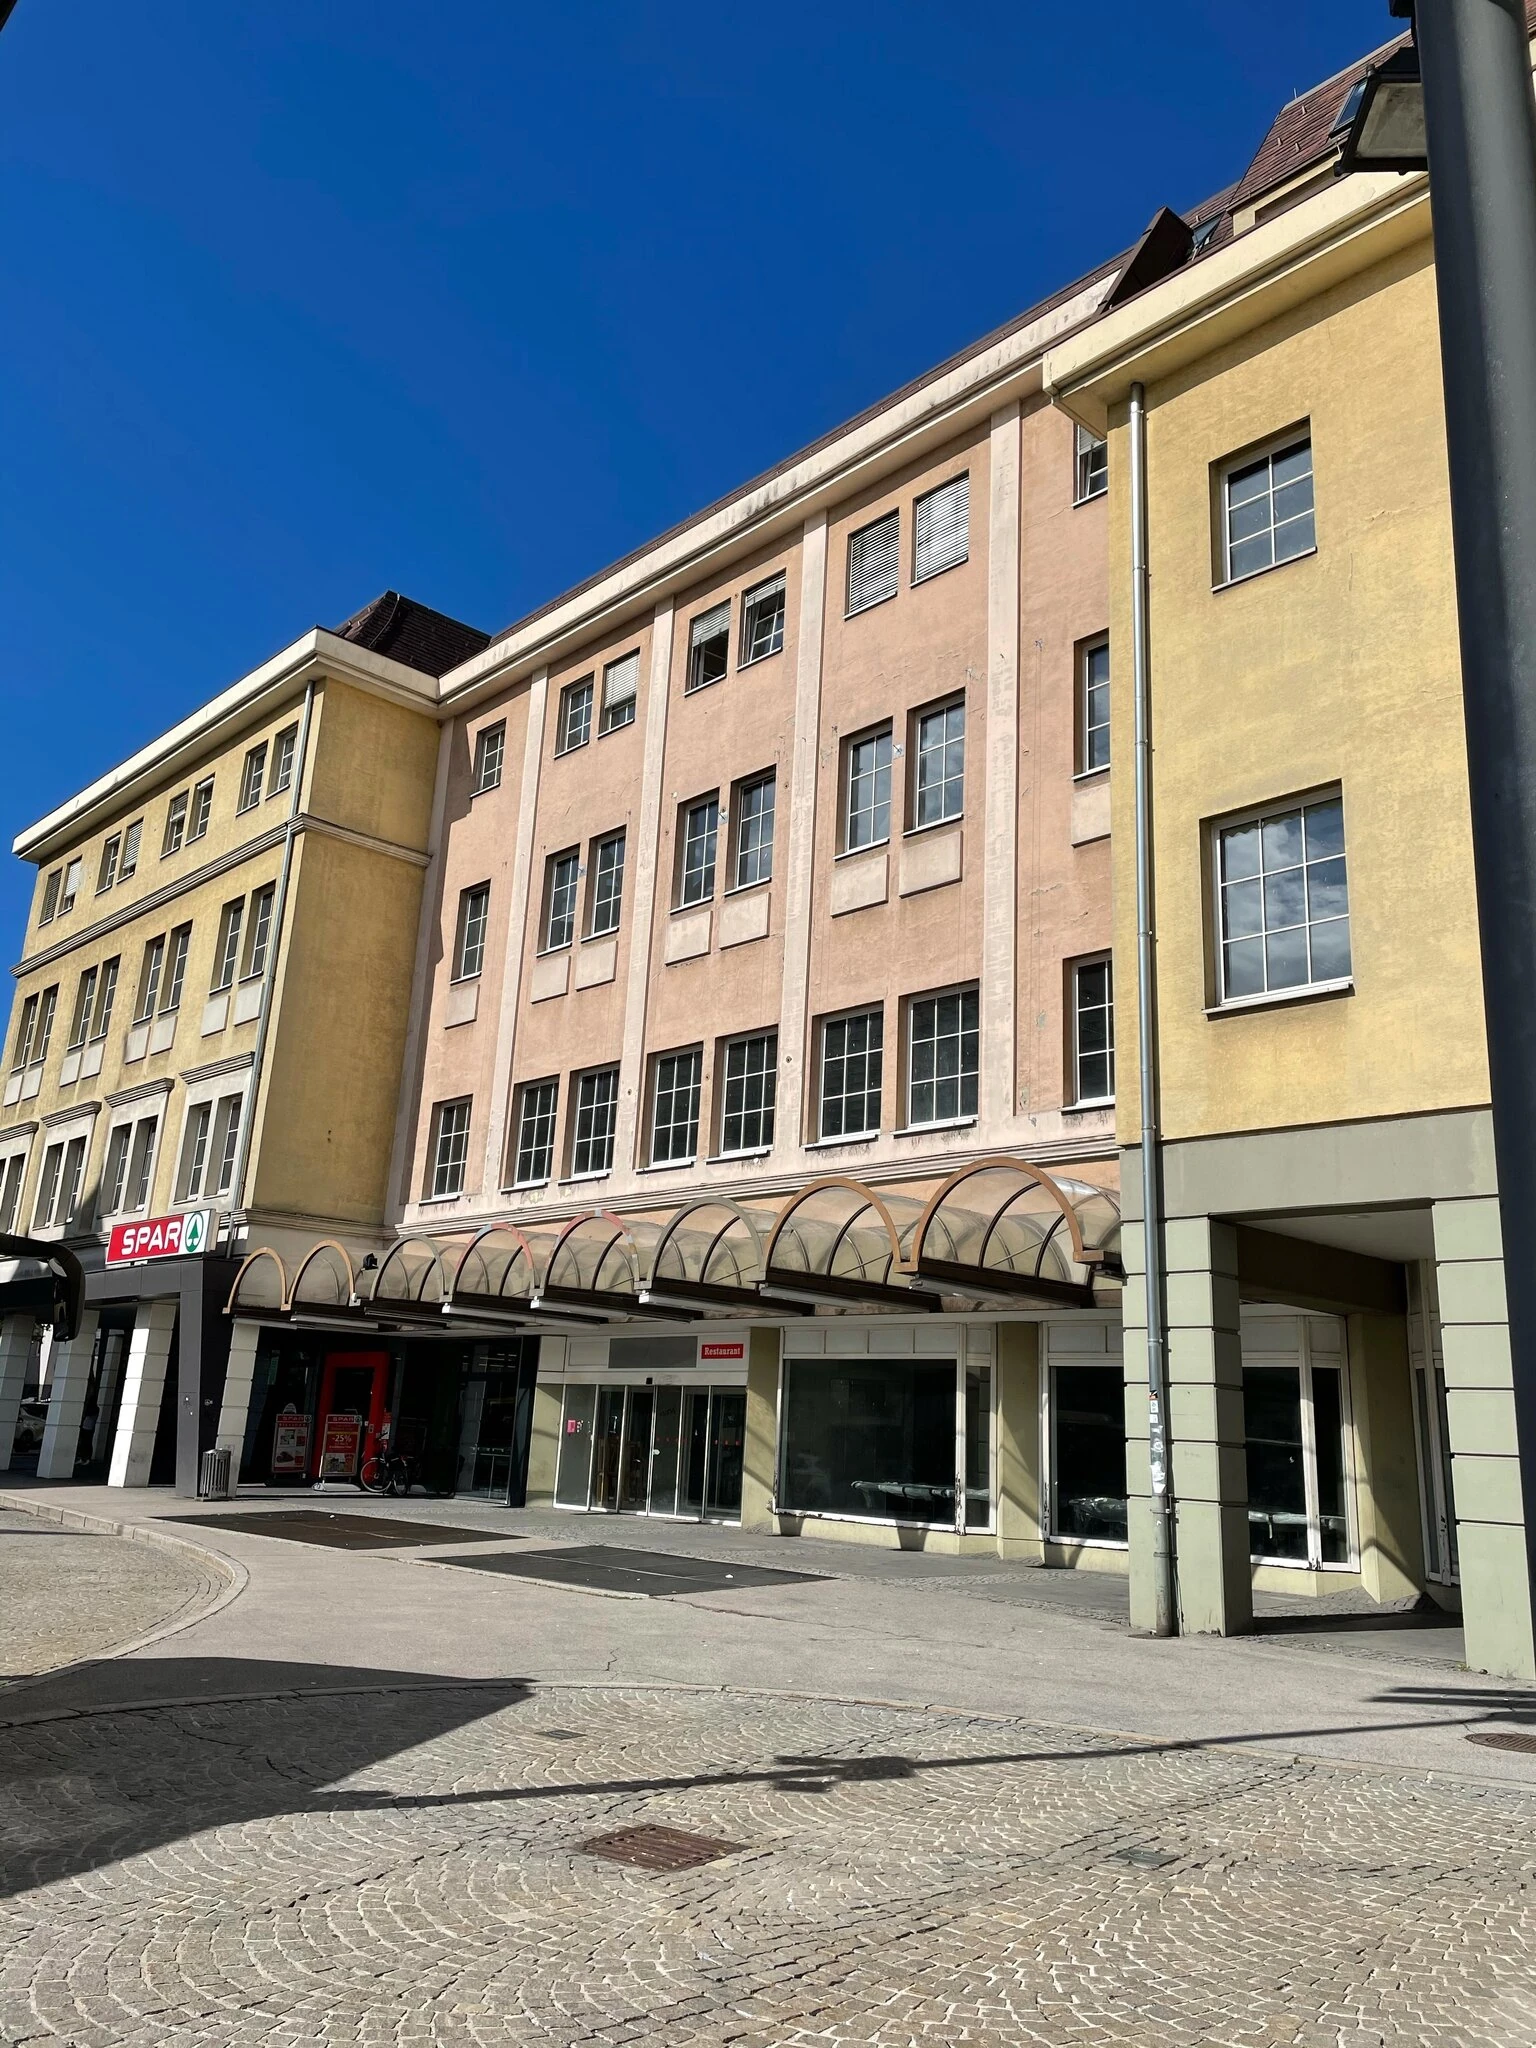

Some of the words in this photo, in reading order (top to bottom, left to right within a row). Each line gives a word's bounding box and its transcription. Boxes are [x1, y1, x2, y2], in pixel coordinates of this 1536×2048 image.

[121, 1221, 181, 1256] SPAR
[704, 1347, 741, 1356] Restaurant
[331, 1434, 352, 1443] -25%
